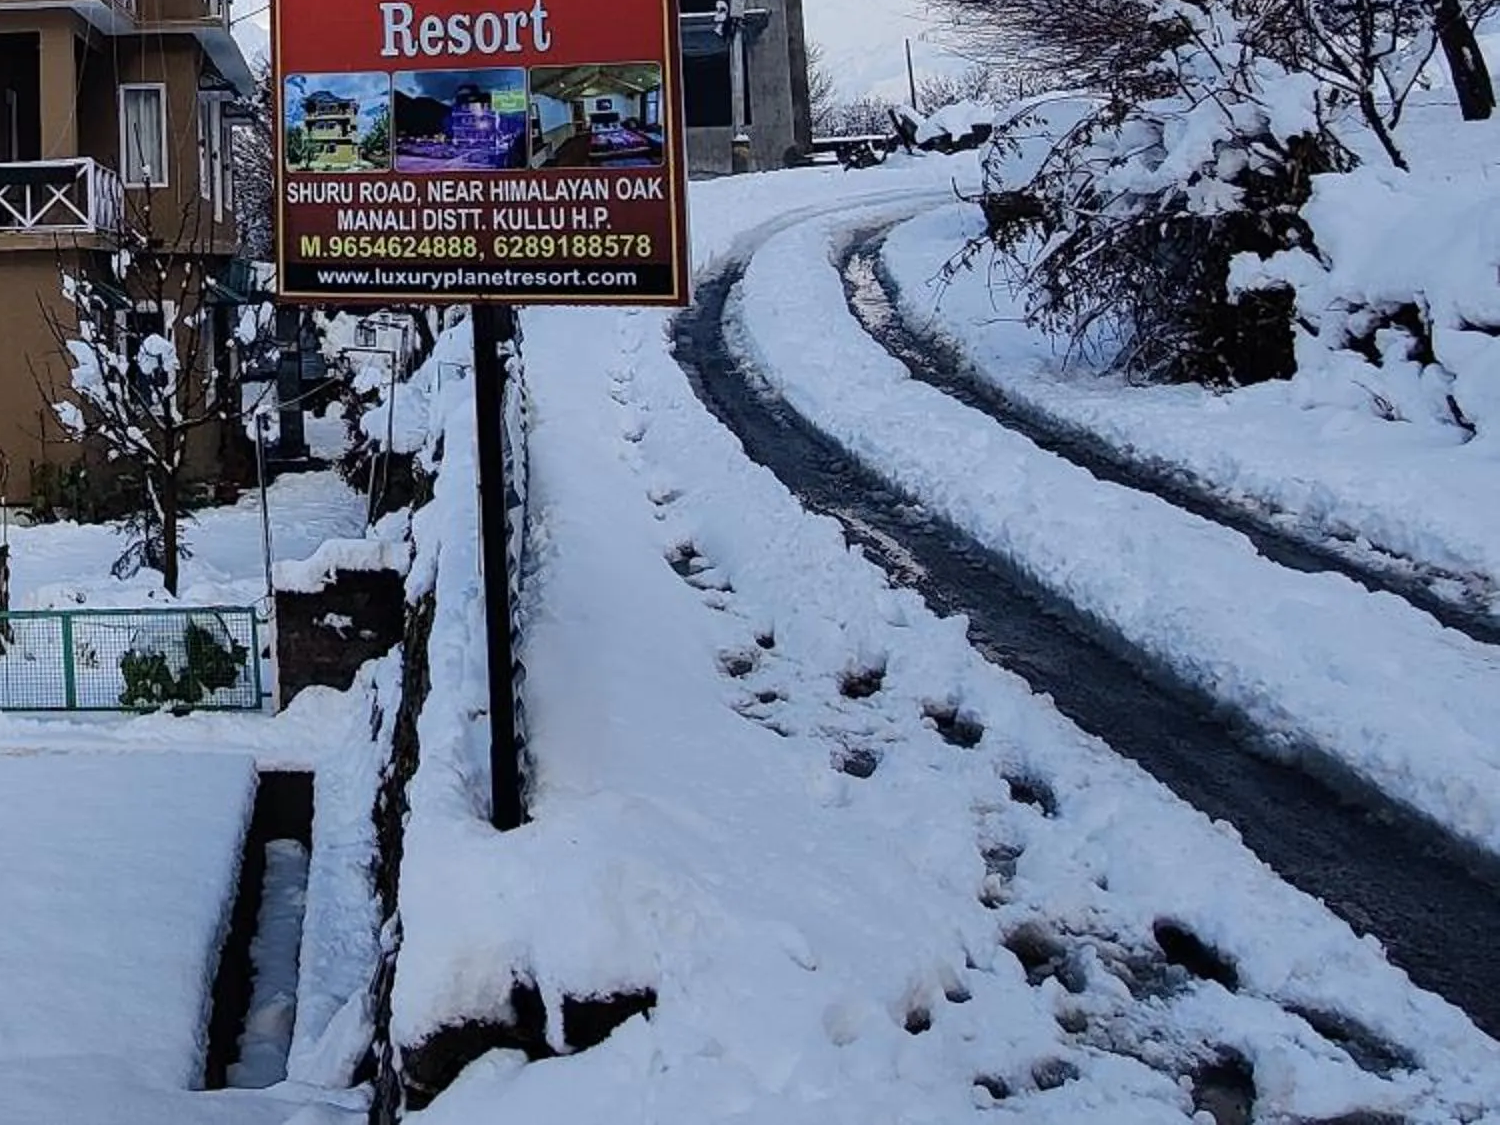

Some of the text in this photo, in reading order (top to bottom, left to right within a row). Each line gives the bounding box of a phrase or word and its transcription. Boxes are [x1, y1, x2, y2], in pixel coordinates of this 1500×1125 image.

[286, 177, 664, 206] SHURU ROAD, NEAR HIMALAYAN OAK
[336, 206, 612, 231] MANALI DISTT. KULLU H.P.
[493, 233, 652, 258] 6289188578
[317, 266, 638, 289] www.luxuryplanetresort.com
